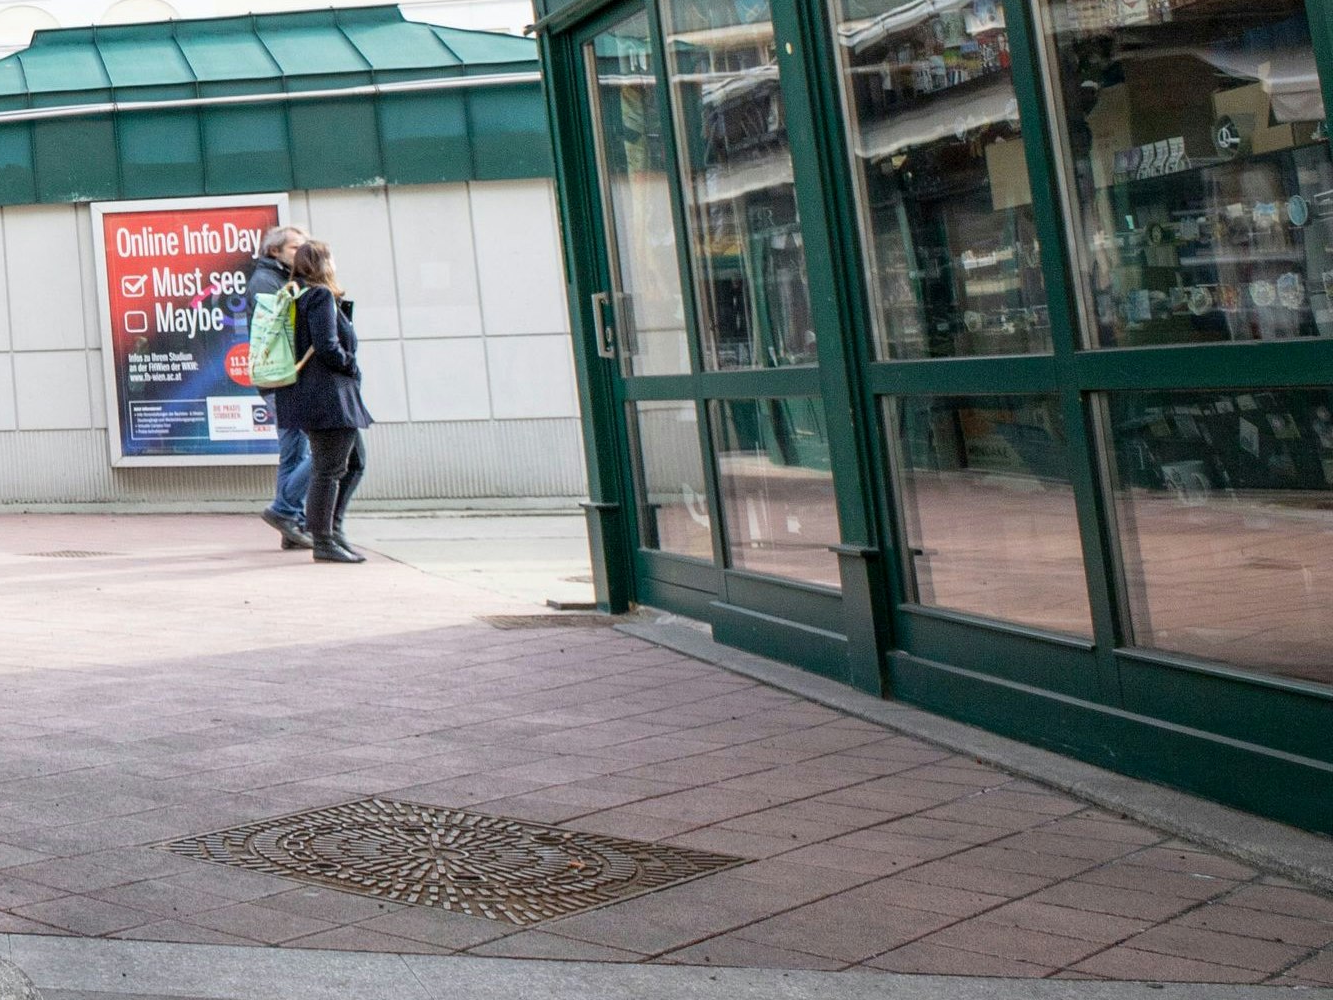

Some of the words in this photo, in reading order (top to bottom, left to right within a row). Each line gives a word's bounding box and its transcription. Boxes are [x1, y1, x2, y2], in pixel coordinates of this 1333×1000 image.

[116, 227, 179, 258] Online
[183, 223, 222, 255] Info
[223, 222, 262, 259] Day
[152, 266, 205, 297] Must
[209, 270, 246, 295] see
[155, 300, 224, 339] Maybe
[128, 353, 143, 362] Infos
[144, 354, 150, 362] zu
[151, 352, 168, 361] Ihrem
[169, 351, 193, 361] Studium
[129, 364, 137, 373] an
[138, 363, 147, 373] der
[171, 362, 181, 372] der
